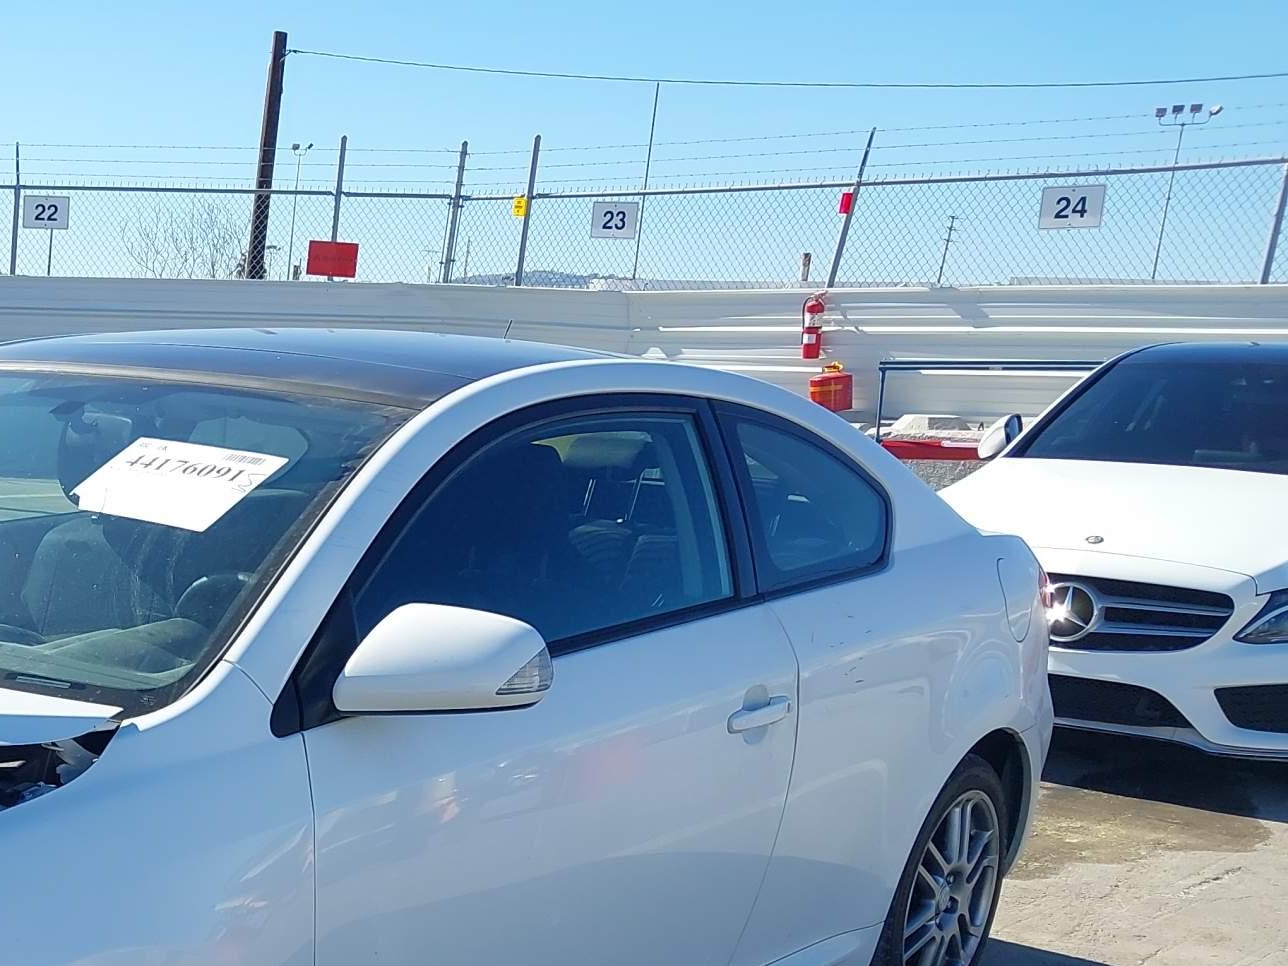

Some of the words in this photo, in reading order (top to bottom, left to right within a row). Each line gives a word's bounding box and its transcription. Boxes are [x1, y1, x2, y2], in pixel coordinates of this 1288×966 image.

[34, 203, 58, 222] 22
[1054, 196, 1088, 219] 24
[602, 210, 626, 230] 23
[125, 454, 246, 482] 44176091
